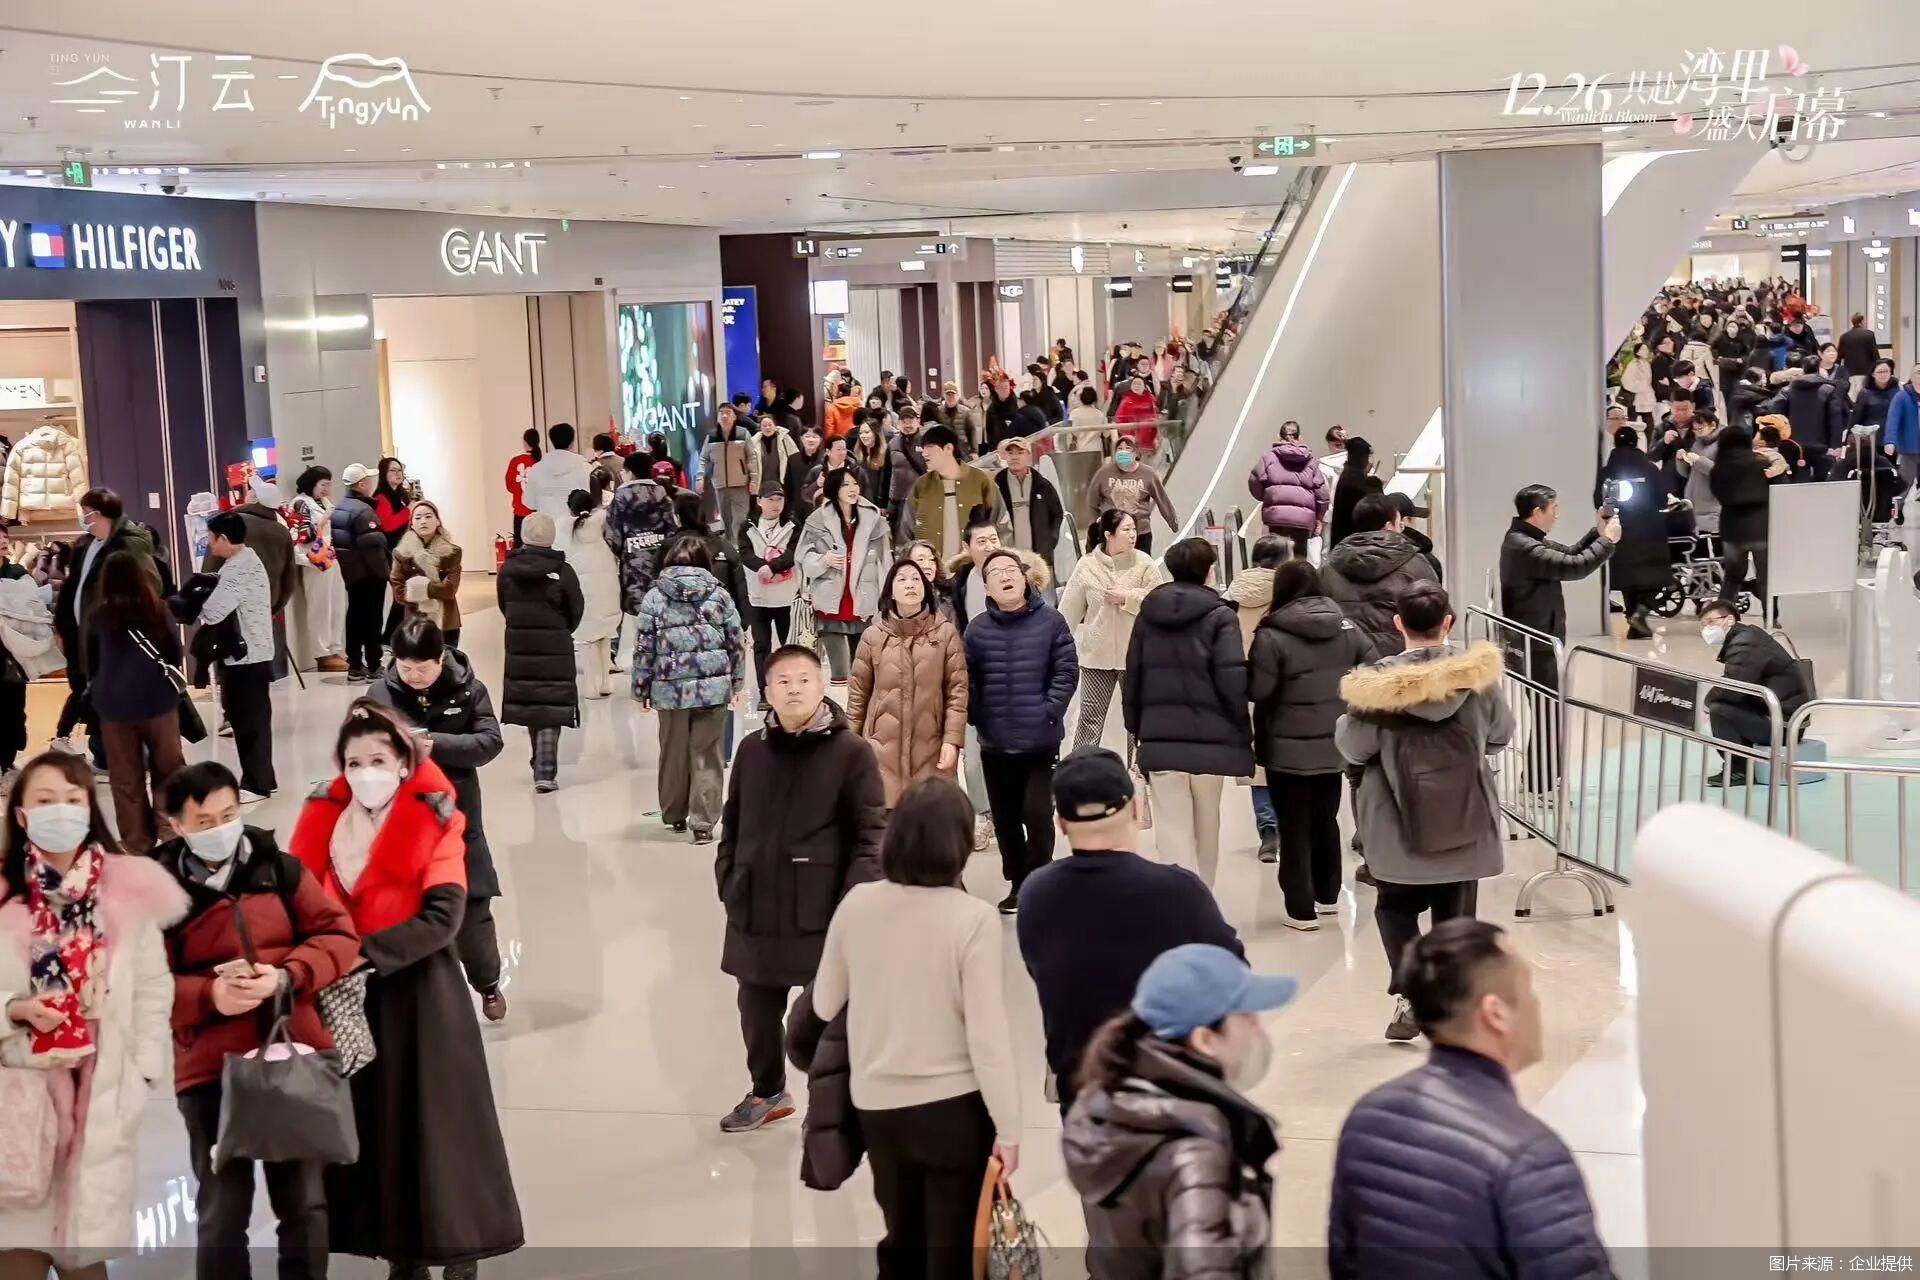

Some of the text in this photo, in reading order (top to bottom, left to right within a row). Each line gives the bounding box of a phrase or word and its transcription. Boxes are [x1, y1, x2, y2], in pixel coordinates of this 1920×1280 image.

[72, 223, 202, 270] HILFIGER
[441, 228, 548, 276] GANT
[796, 240, 815, 254] L1
[641, 402, 701, 434] GANT
[1108, 477, 1145, 489] PANDA
